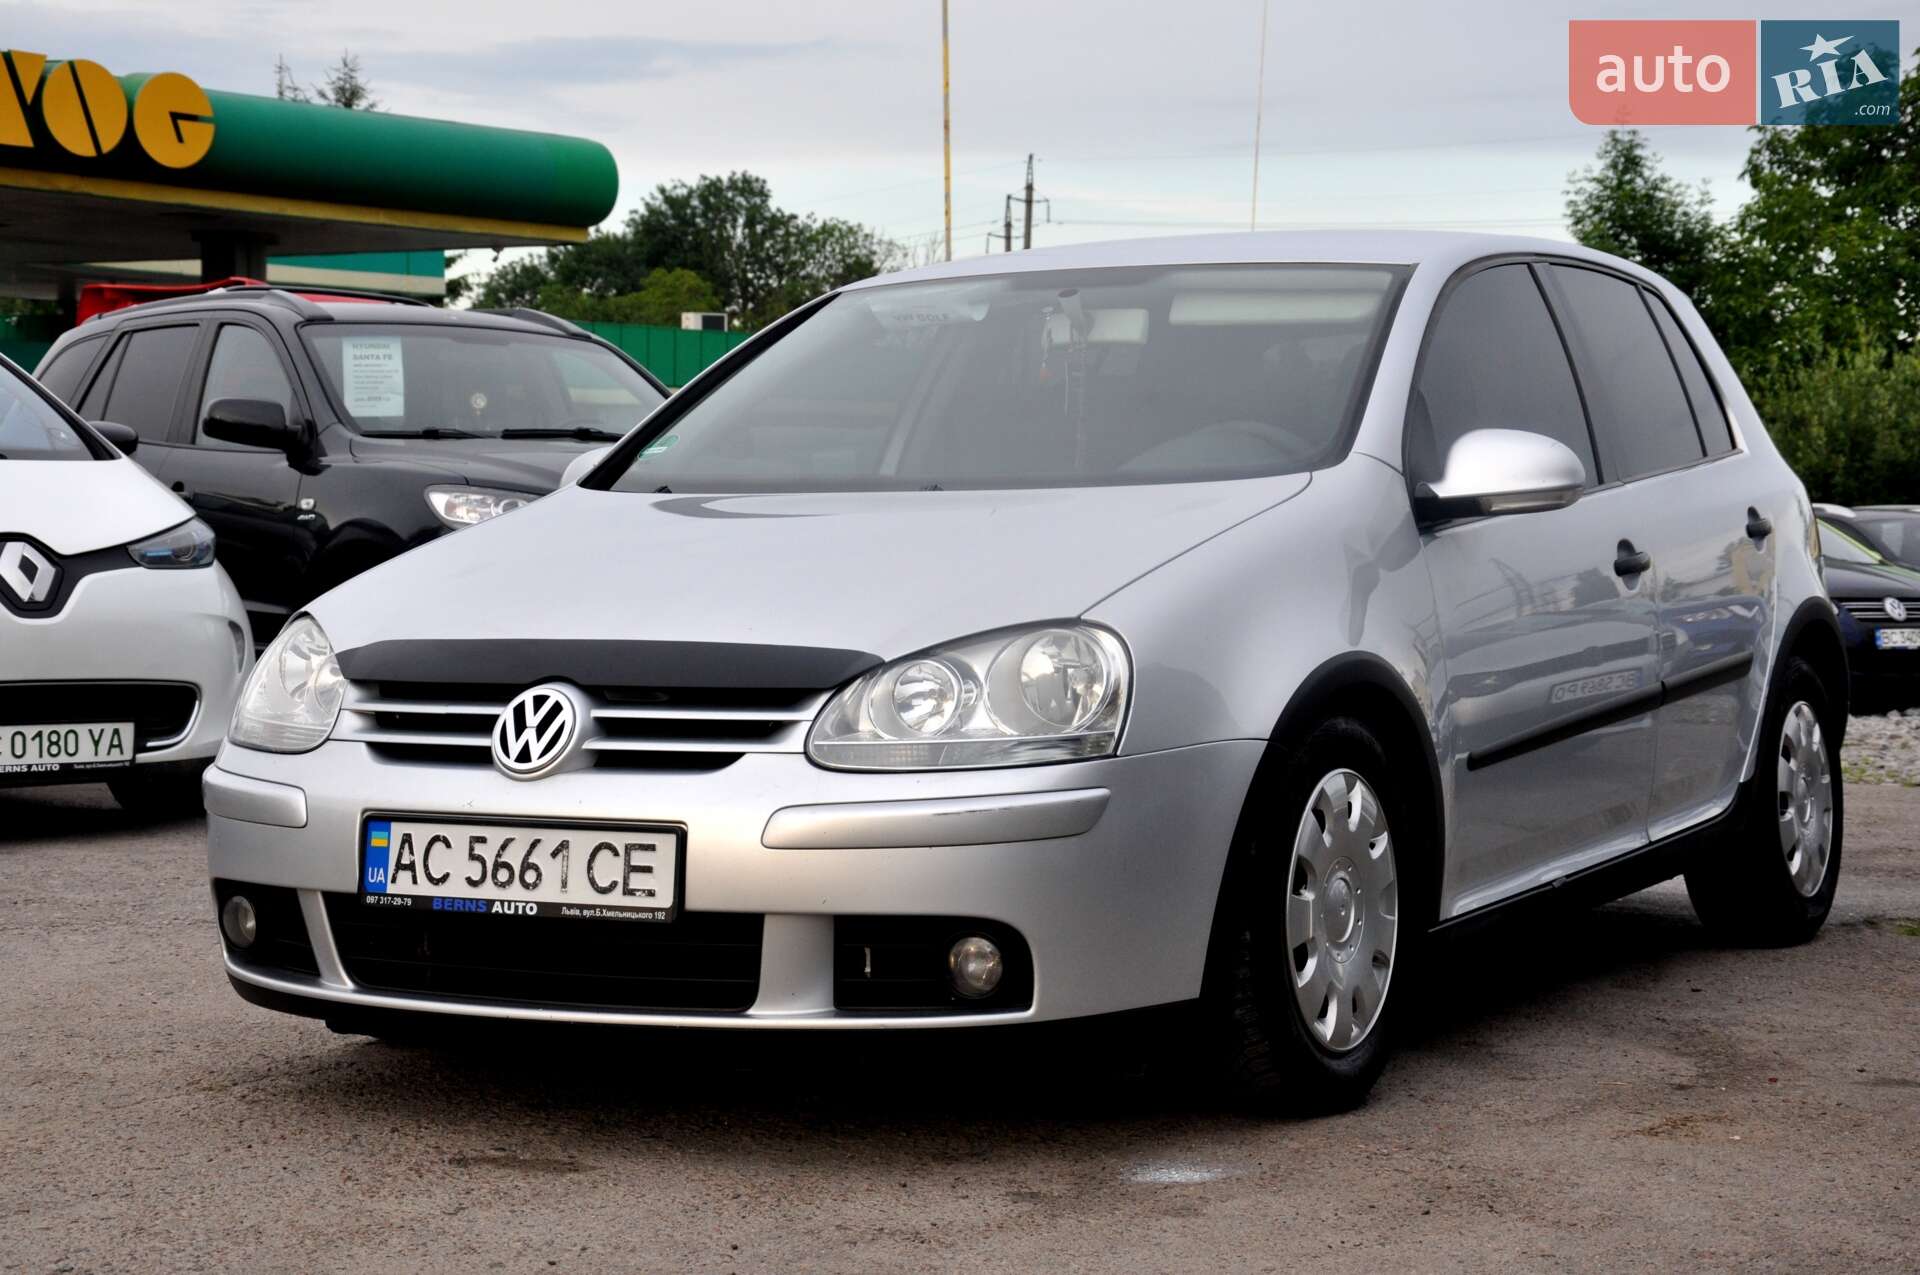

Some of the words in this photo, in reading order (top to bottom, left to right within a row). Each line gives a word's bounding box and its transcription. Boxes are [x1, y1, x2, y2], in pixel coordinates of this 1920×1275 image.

[352, 353, 382, 361] SANTA
[11, 729, 79, 759] 0180
[88, 728, 124, 756] YA
[30, 763, 60, 772] AUTO
[390, 832, 453, 886] AC
[465, 835, 571, 895] 5661
[586, 841, 657, 898] CE
[368, 866, 386, 884] UA
[366, 895, 379, 904] 097
[379, 896, 412, 906] 317-29-79
[432, 898, 487, 913] BERNS
[491, 901, 538, 915] AUTO
[654, 911, 666, 920] 192
